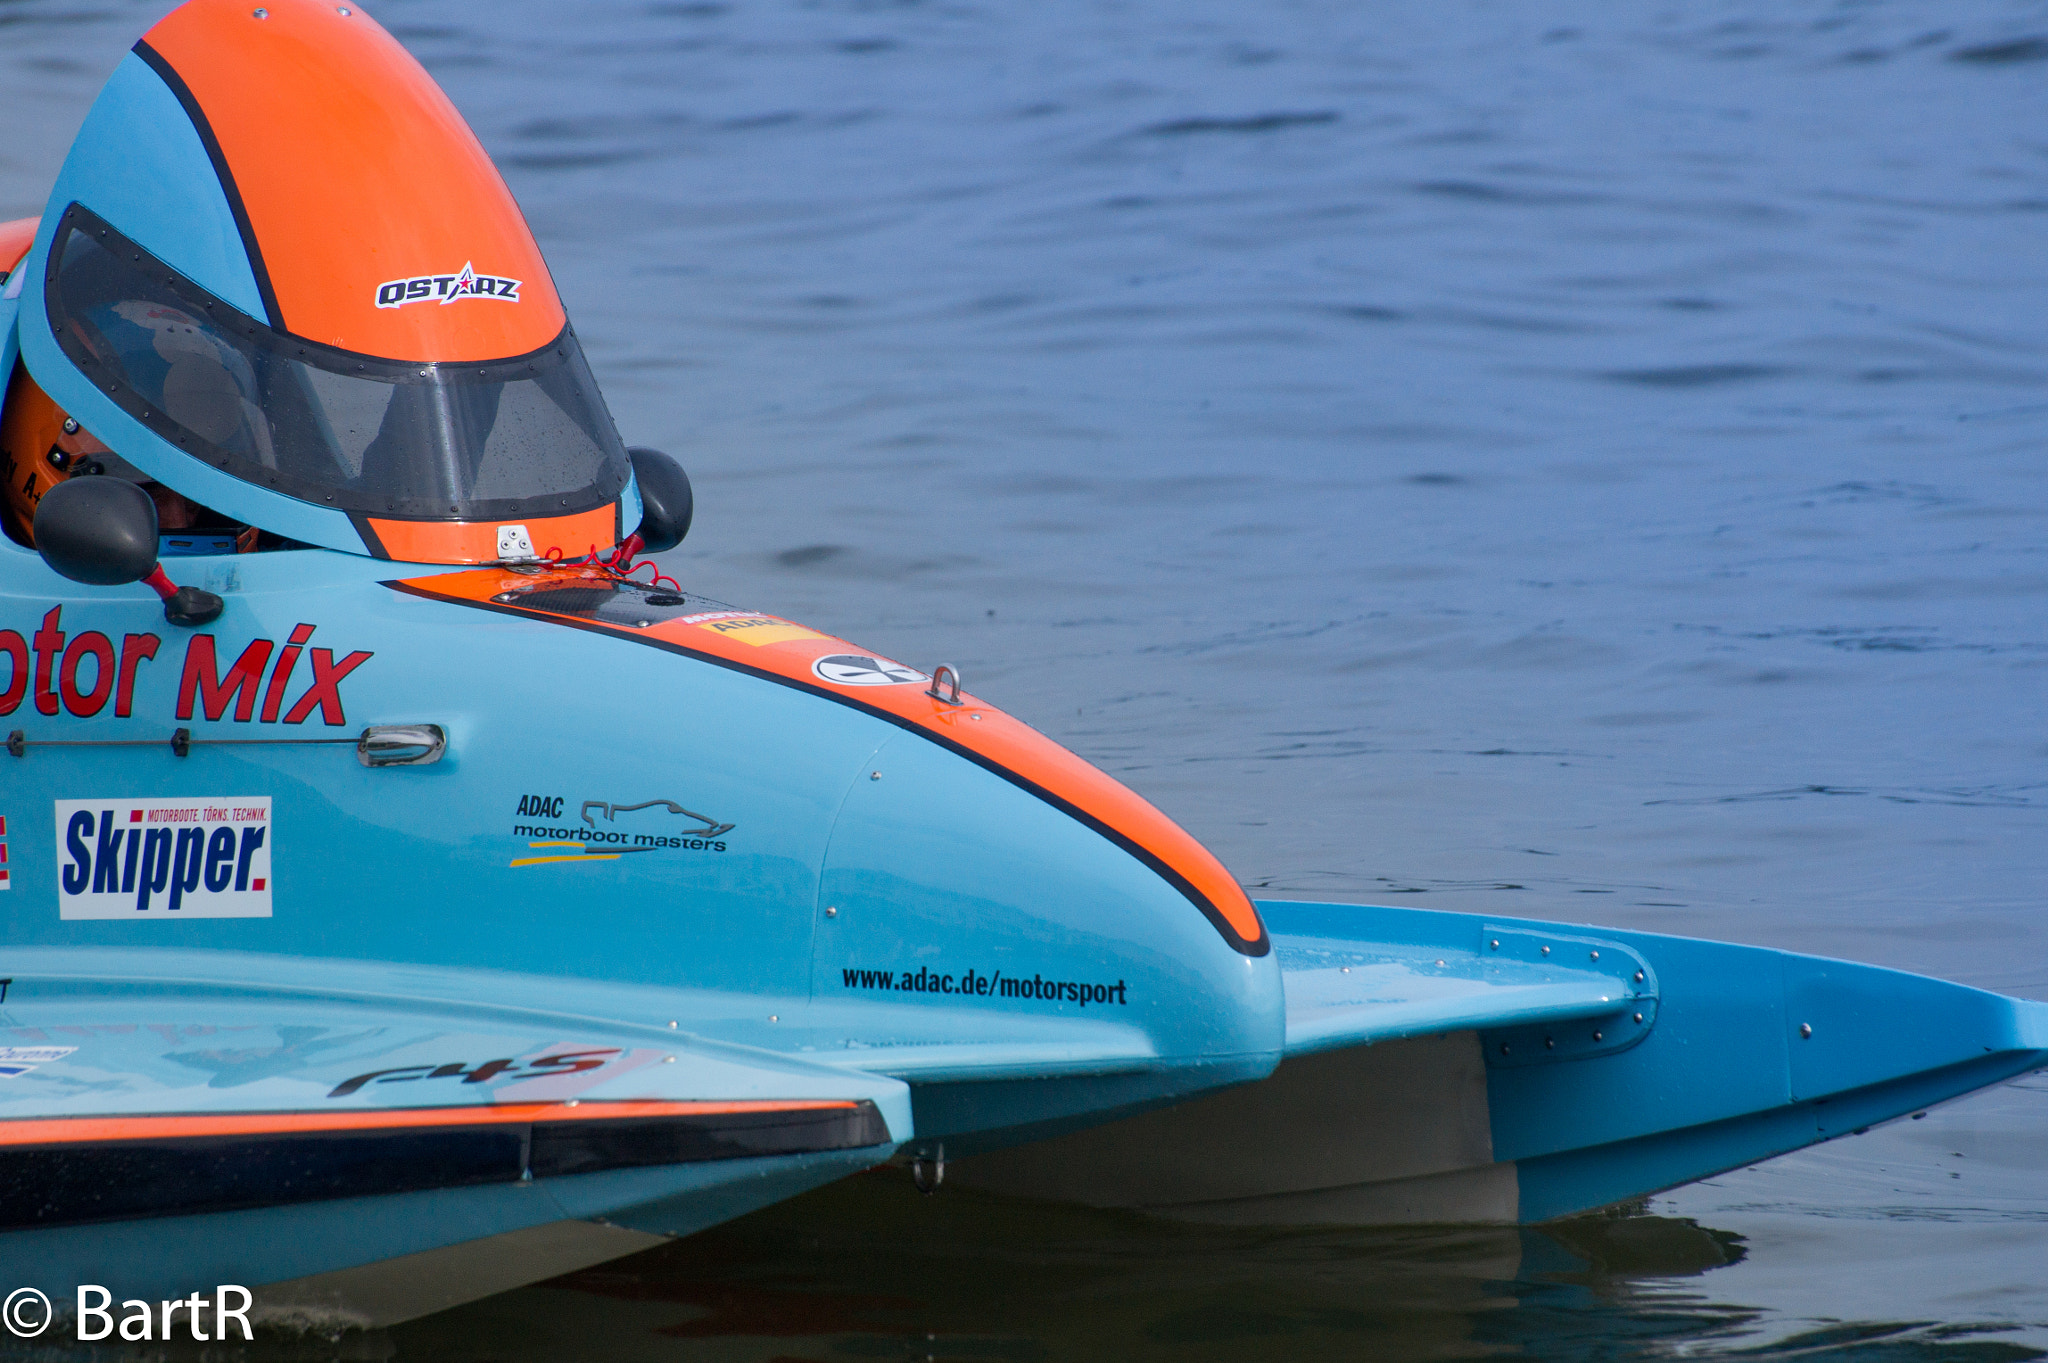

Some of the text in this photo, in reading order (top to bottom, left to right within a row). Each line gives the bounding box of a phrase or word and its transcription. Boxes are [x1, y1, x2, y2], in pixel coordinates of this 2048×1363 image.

[378, 267, 519, 305] QSTARZ
[175, 622, 375, 726] Mix
[148, 808, 200, 823] MOTORBOOTE.
[232, 807, 267, 821] TECHNIK.
[516, 794, 564, 819] ADAC
[513, 823, 727, 852] motorboot masters
[842, 966, 1127, 1007] www.adac.de/motorsport
